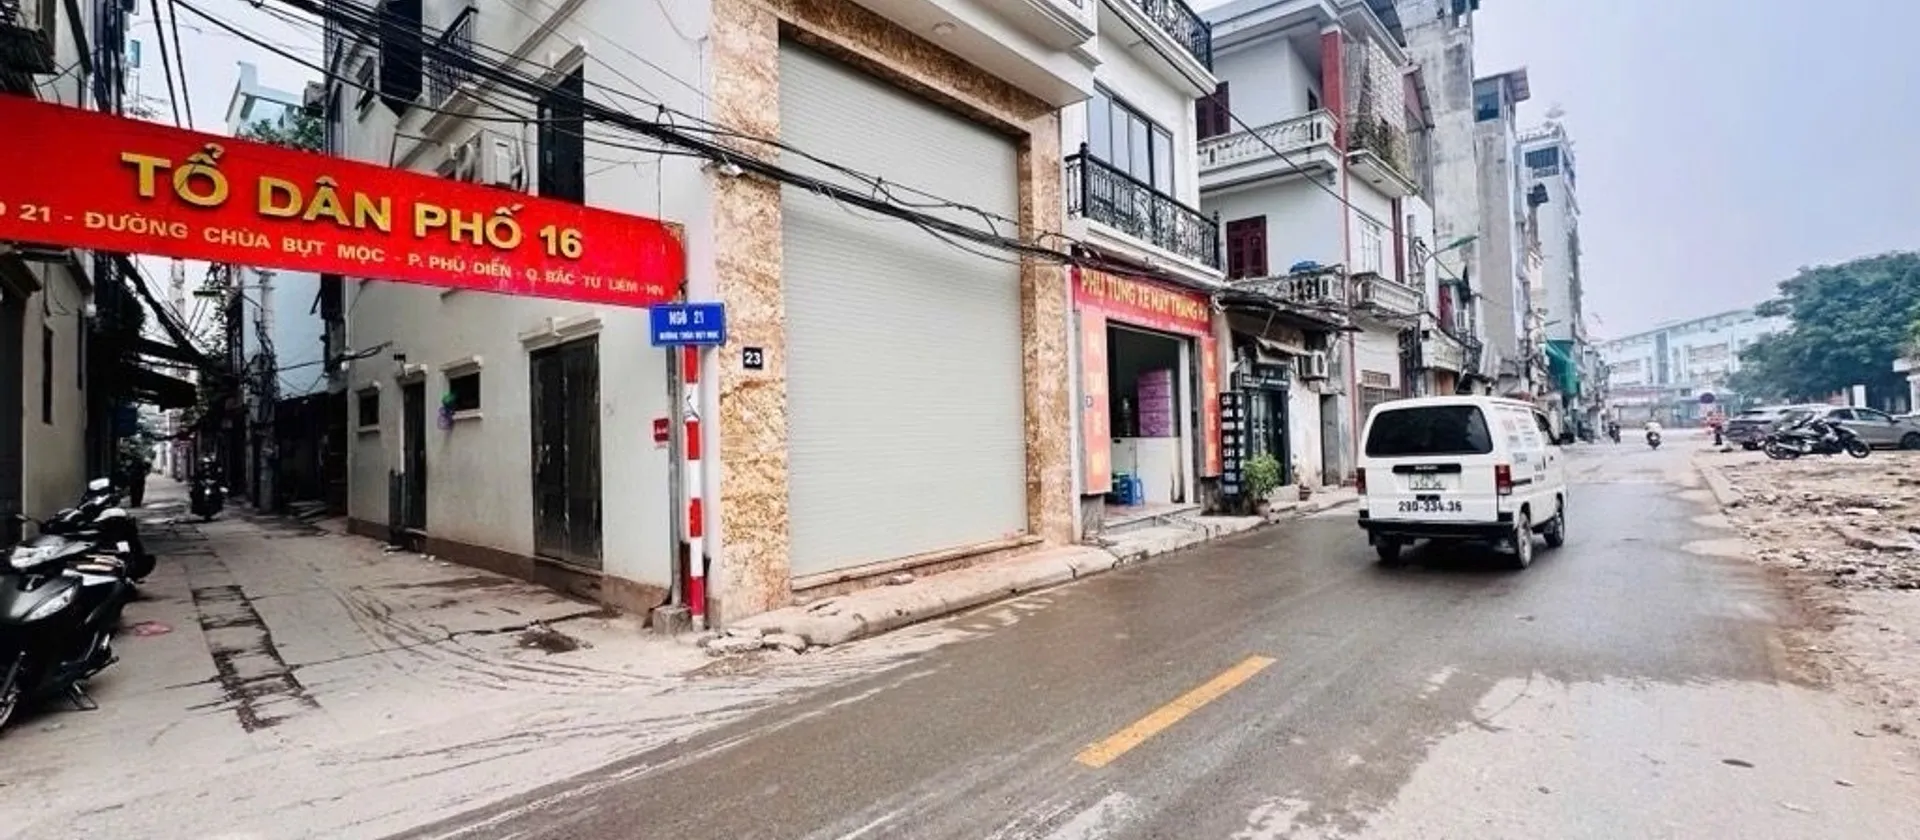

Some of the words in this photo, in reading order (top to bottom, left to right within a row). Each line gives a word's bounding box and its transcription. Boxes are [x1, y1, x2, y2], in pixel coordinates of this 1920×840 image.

[121, 142, 229, 207] TỔ
[258, 175, 393, 233] DÂN
[414, 202, 525, 250] PHỐ
[539, 224, 585, 259] 16
[20, 204, 51, 222] 21
[84, 211, 189, 239] ĐƯỜNG
[204, 227, 271, 249] CHÙA
[283, 236, 326, 257] BỤT
[338, 243, 385, 264] MỌC
[693, 310, 704, 324] 21
[744, 351, 761, 365] 23
